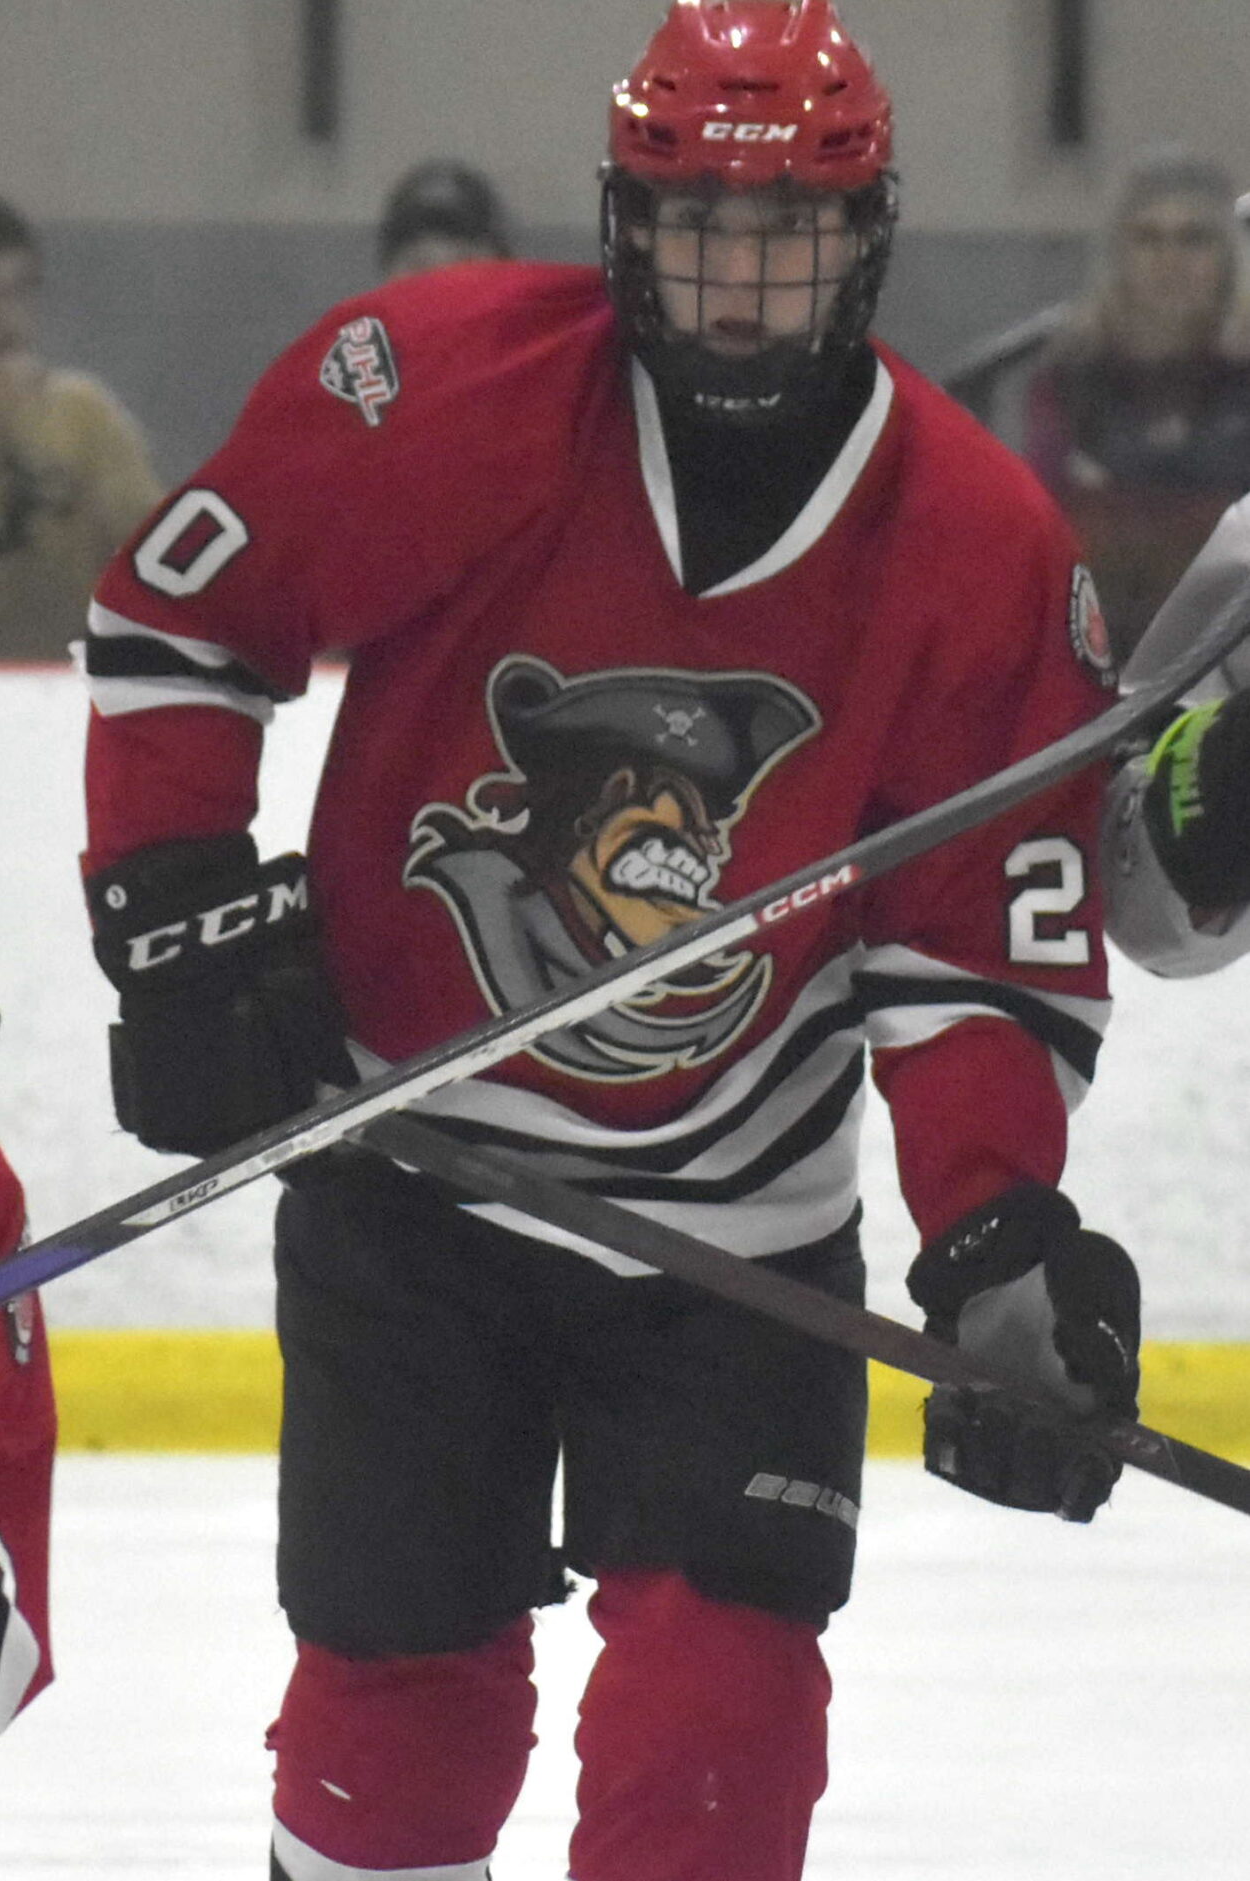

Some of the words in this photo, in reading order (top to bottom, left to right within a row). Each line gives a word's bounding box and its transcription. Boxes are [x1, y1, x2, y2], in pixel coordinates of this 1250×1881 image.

[702, 121, 798, 142] CCM
[134, 489, 249, 597] 0
[126, 873, 309, 971] CCM
[762, 864, 854, 923] CCM
[1004, 836, 1090, 965] 2
